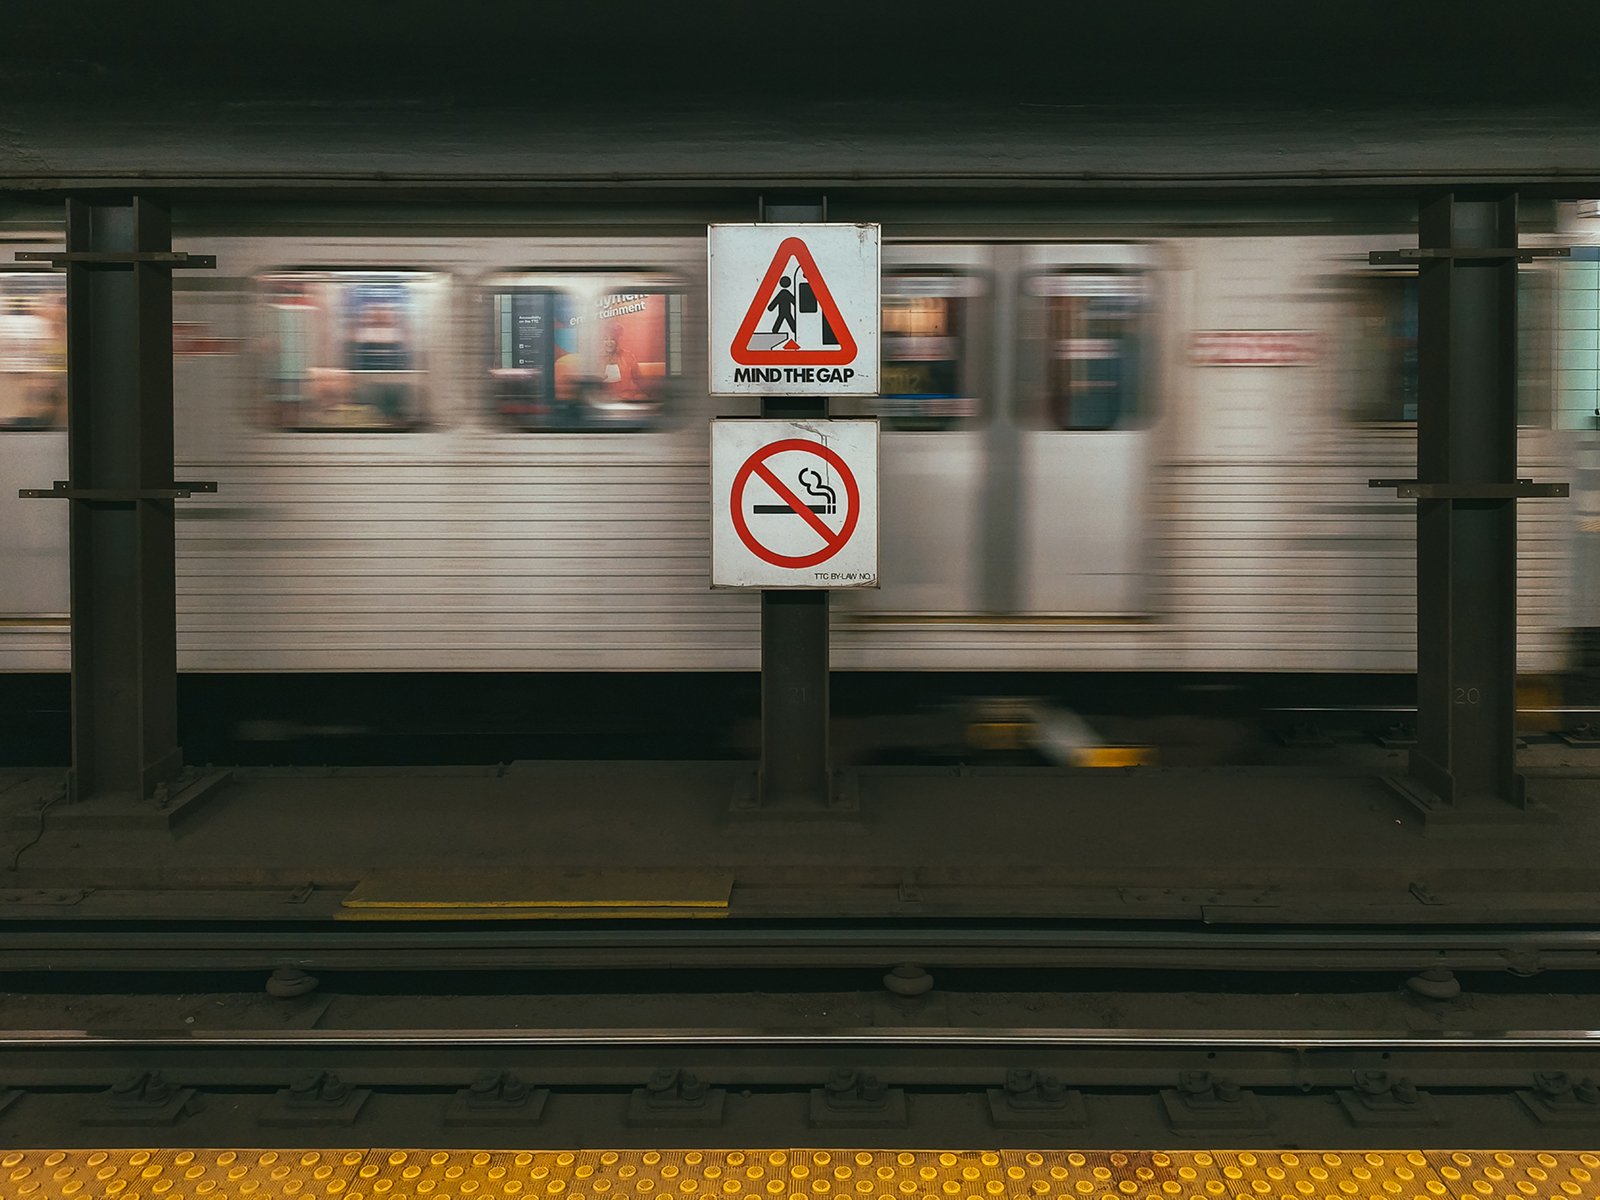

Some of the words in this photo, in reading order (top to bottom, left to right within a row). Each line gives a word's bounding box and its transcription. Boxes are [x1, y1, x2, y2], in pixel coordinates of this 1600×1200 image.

[733, 368, 783, 383] MIND
[784, 368, 815, 383] THE
[816, 368, 855, 383] GAP
[814, 572, 829, 580] TTC
[1455, 687, 1481, 705] 20
